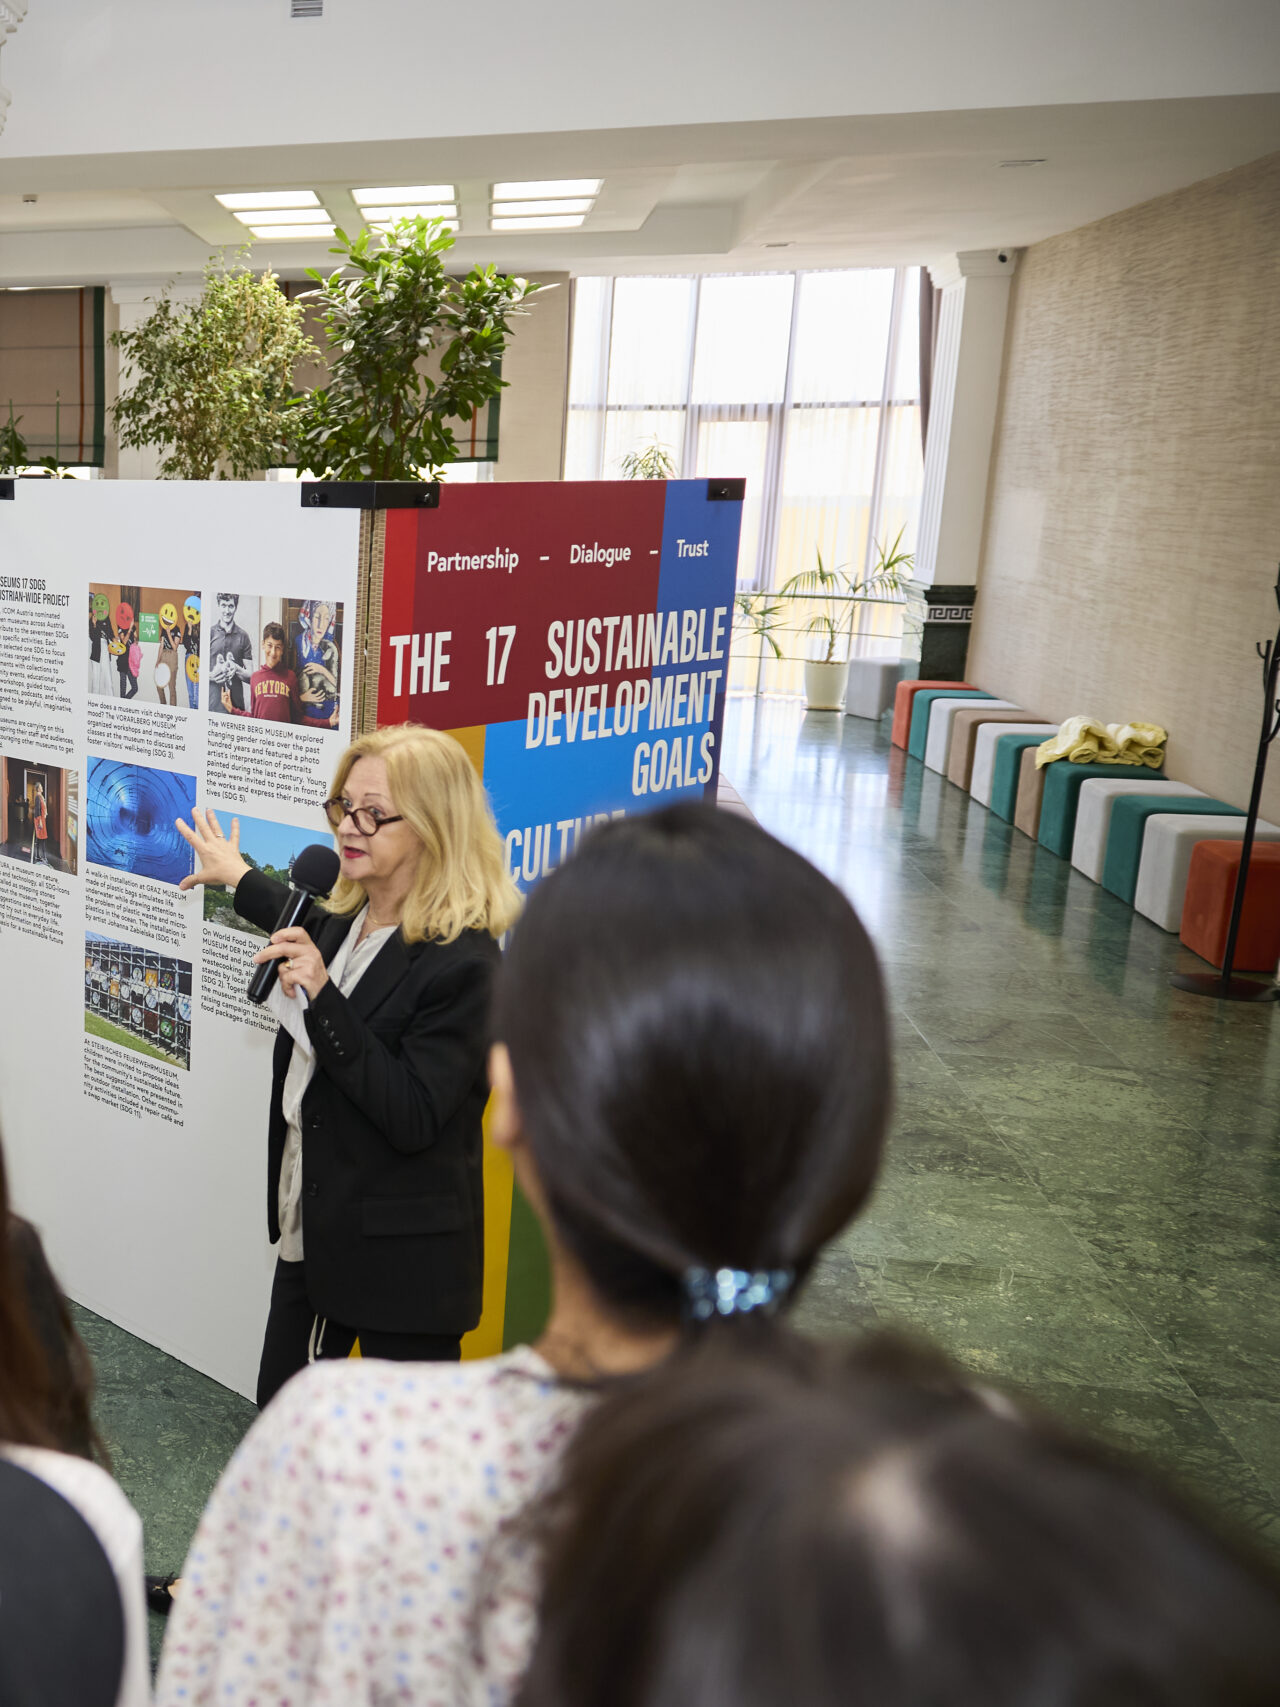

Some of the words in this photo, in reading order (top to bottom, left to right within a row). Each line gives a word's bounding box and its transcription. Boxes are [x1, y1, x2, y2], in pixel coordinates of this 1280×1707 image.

[428, 547, 519, 573] Partnership
[570, 542, 631, 567] Dialogue
[677, 539, 709, 557] Trust
[22, 578, 28, 589] 17
[30, 579, 46, 590] SDGS
[43, 594, 69, 606] PROJECT
[390, 631, 452, 696] THE
[486, 625, 516, 685] 17
[545, 607, 727, 680] SUSTAINABLE
[526, 670, 723, 749] DEVELOPMENT
[208, 719, 219, 727] The
[221, 721, 245, 731] WERNER
[247, 725, 263, 734] BERG
[265, 728, 293, 739] MUSEUM
[295, 735, 324, 744] explored
[208, 730, 235, 742] changing
[236, 735, 258, 744] gender
[260, 738, 275, 746] roles
[293, 743, 303, 751] the
[207, 750, 228, 759] artist's
[230, 753, 273, 767] interpretation
[283, 764, 312, 774] portraits
[632, 732, 715, 796] GOALS
[505, 809, 625, 883] CULT
[203, 927, 211, 936] On
[213, 930, 230, 942] World
[232, 936, 247, 946] Food
[248, 941, 261, 951] Day,
[201, 1002, 214, 1013] food
[215, 1009, 243, 1022] packages
